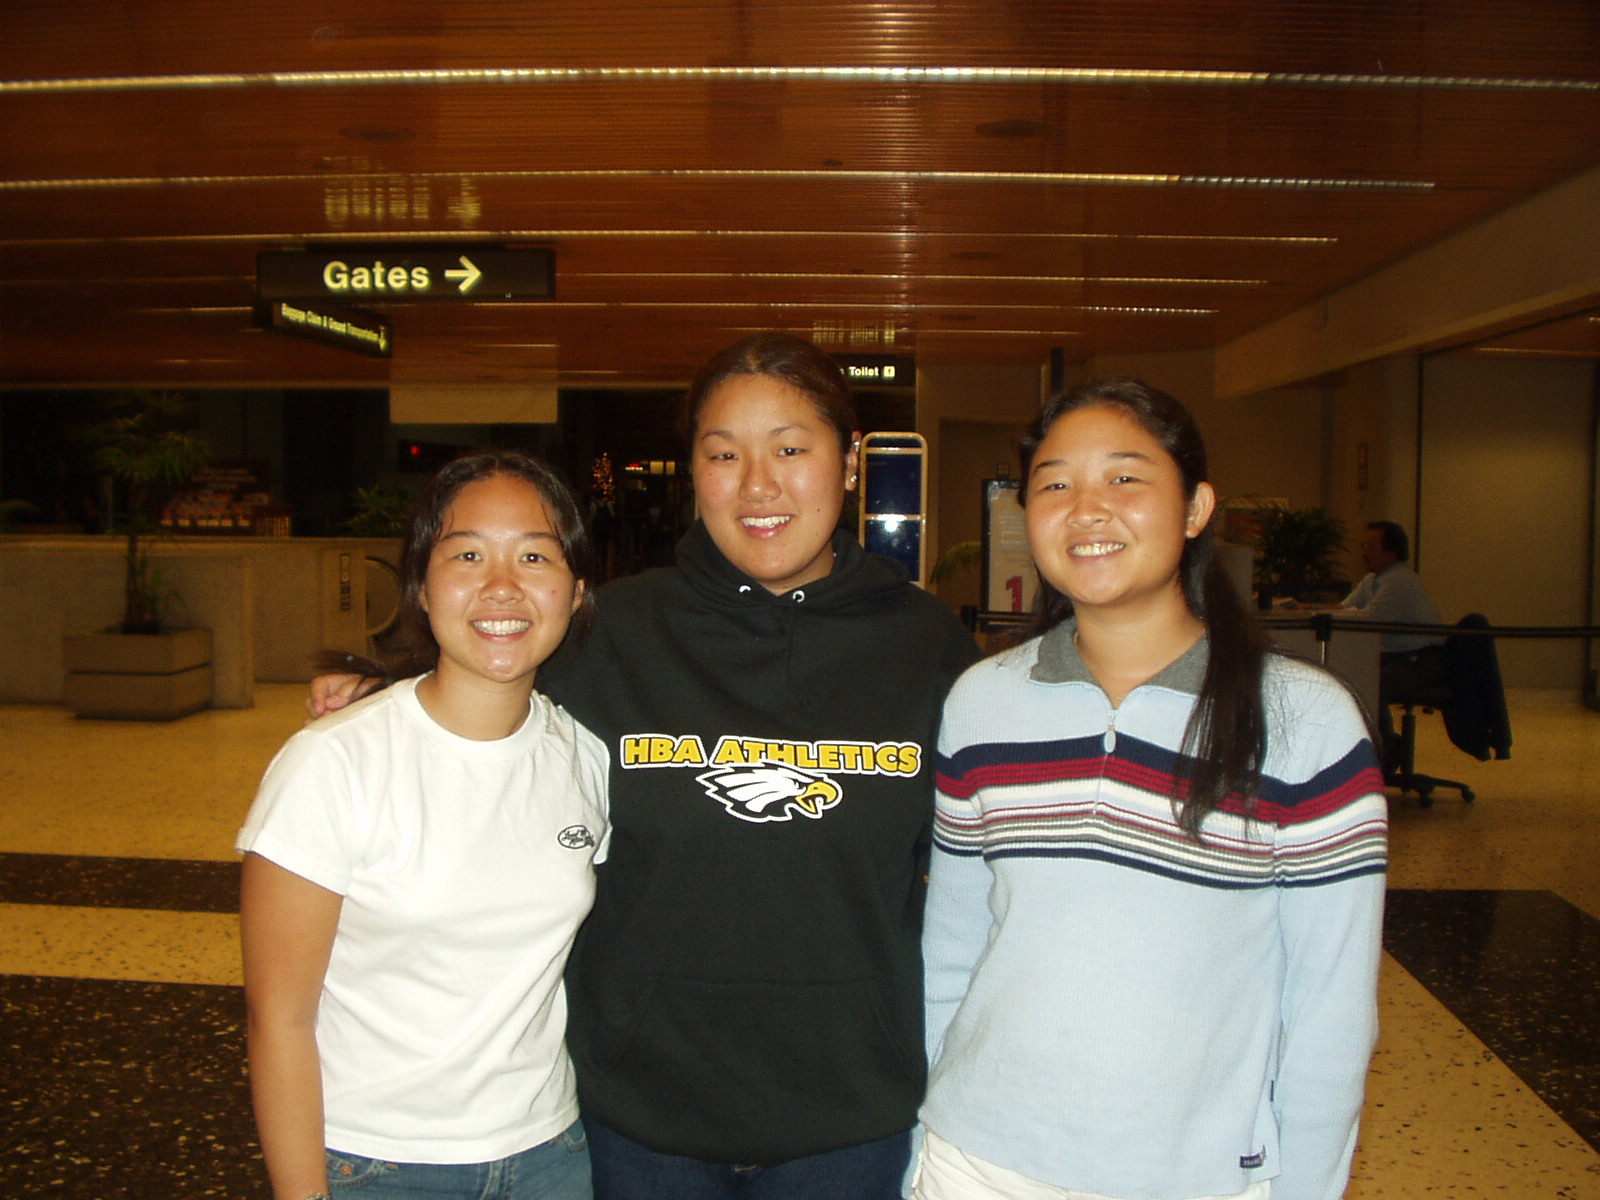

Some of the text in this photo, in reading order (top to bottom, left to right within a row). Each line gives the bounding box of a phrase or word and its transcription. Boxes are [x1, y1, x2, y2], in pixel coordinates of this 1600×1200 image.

[323, 260, 430, 291] Gates
[1006, 576, 1022, 613] 1
[621, 734, 921, 776] HBA ATHLETICS
